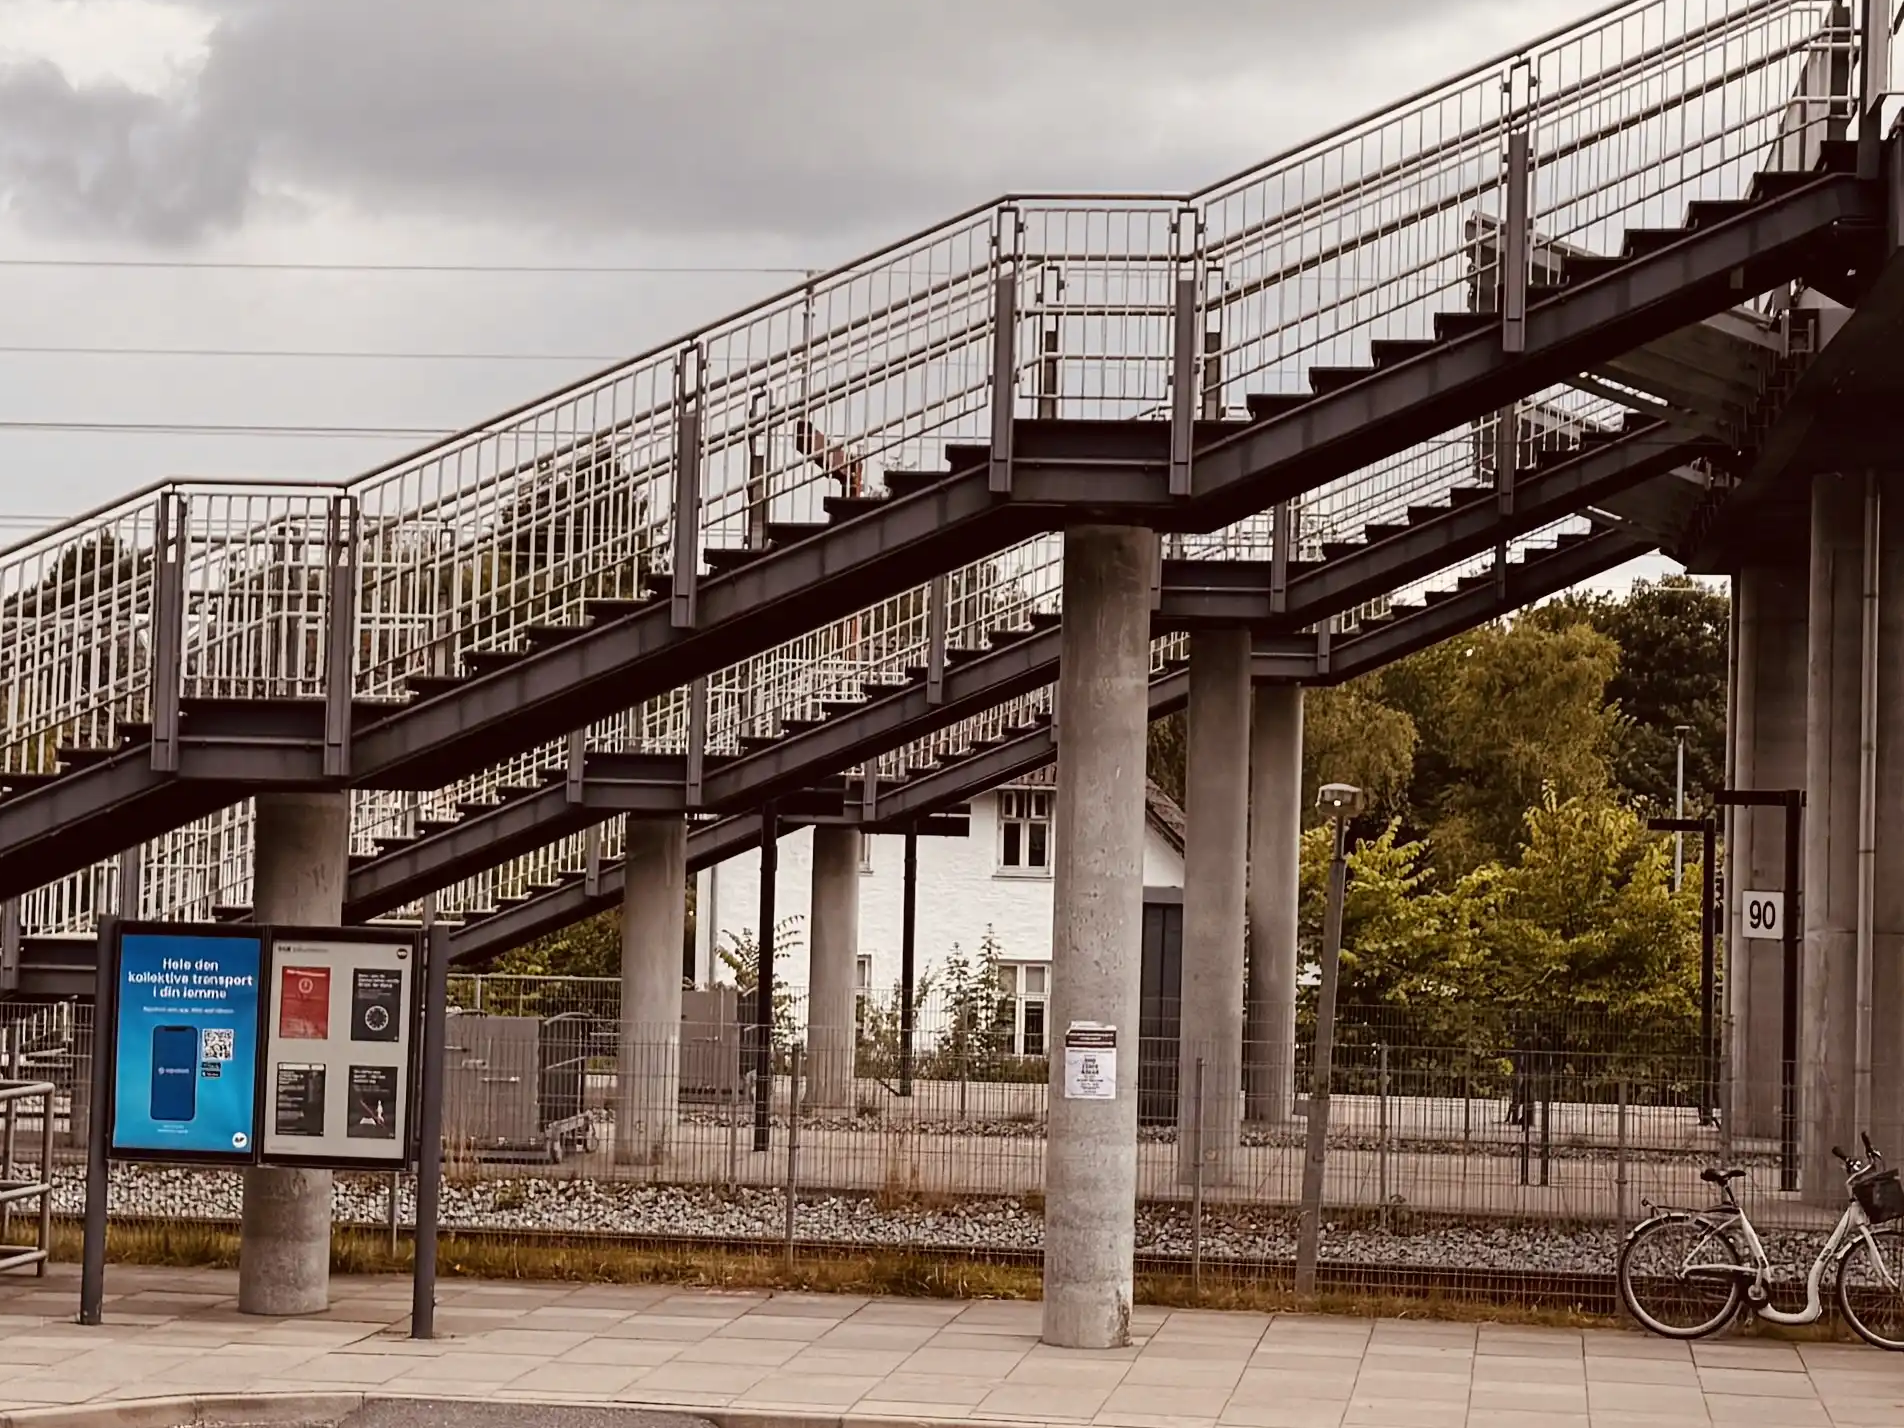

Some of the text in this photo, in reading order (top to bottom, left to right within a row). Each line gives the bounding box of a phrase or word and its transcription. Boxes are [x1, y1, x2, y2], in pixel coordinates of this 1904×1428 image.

[1749, 899, 1776, 930] 90
[162, 957, 219, 972] Hele den
[128, 970, 253, 989] kollektive transport
[159, 985, 181, 998] din
